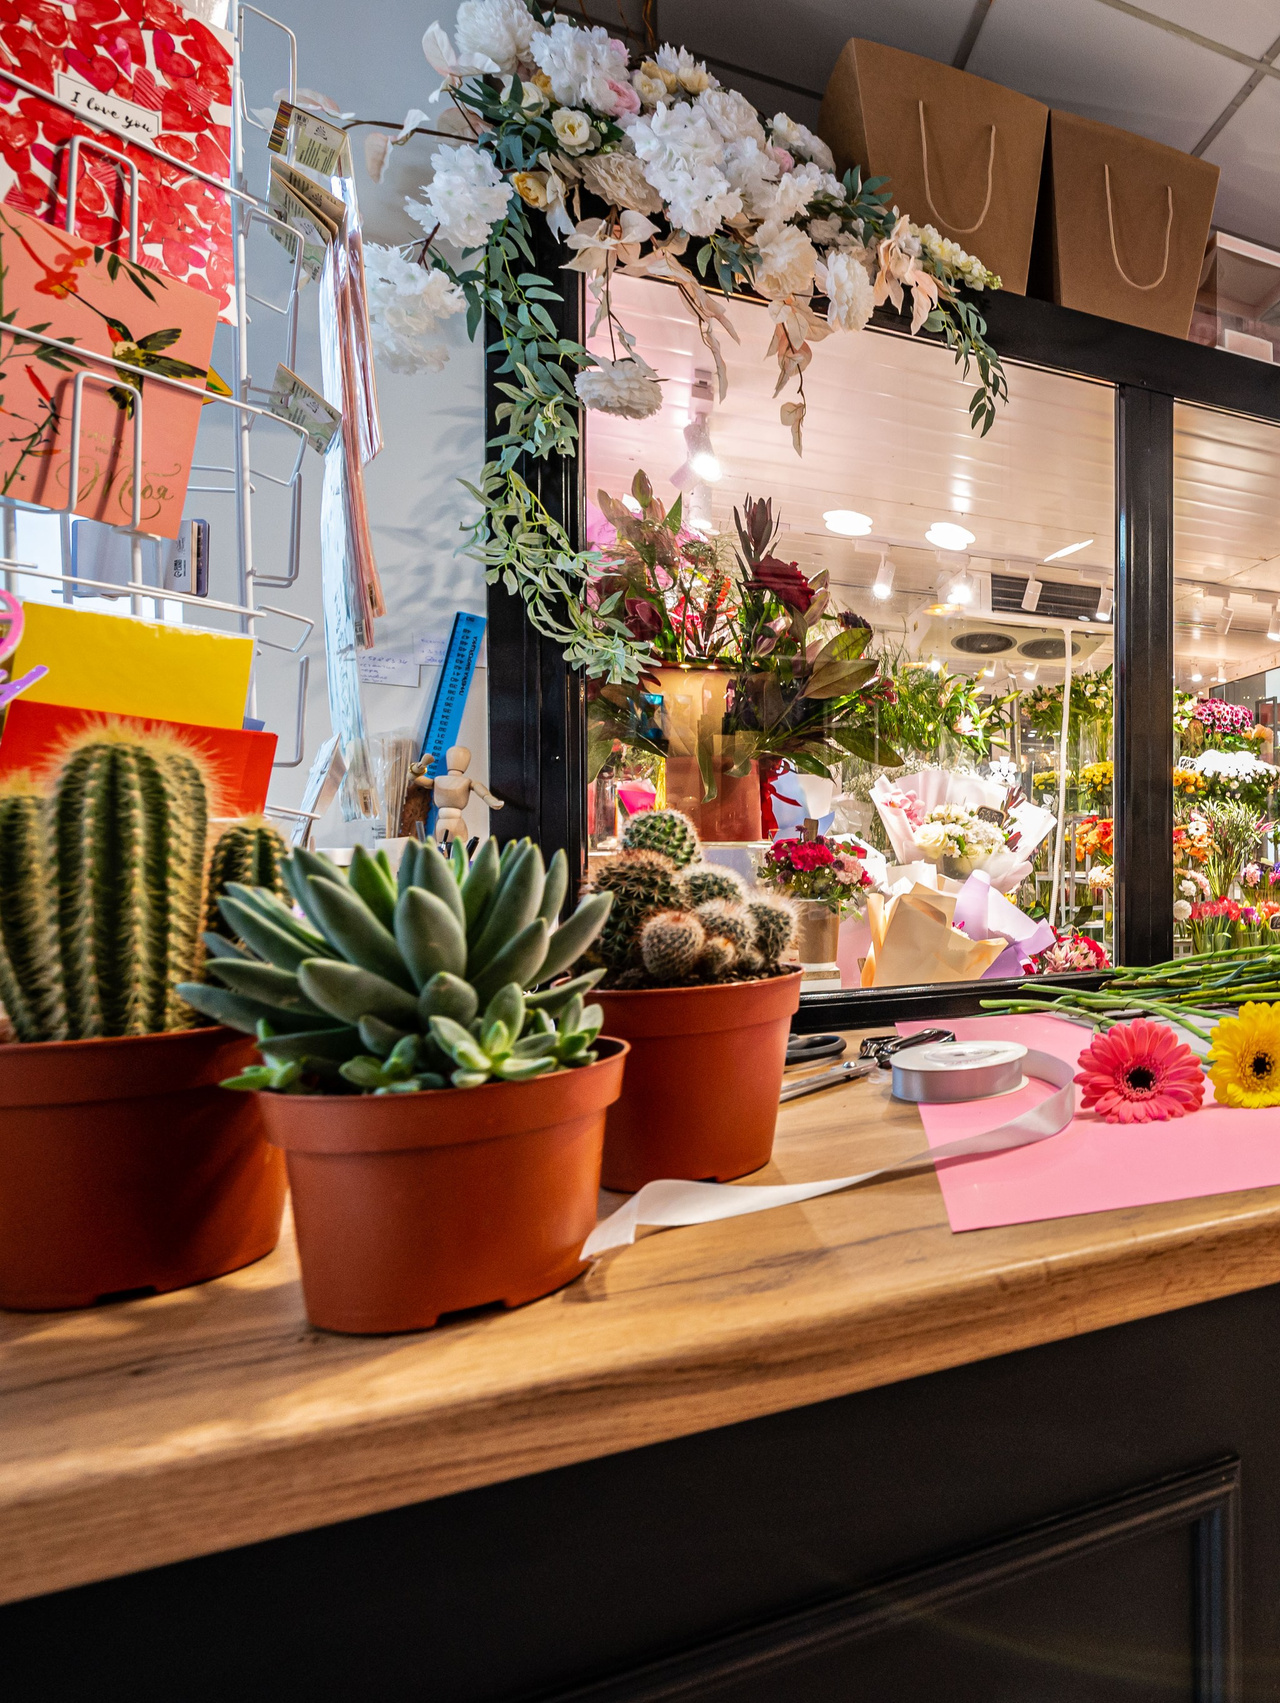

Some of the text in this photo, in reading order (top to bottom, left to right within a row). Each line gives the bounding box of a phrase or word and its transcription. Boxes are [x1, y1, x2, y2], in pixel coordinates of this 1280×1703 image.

[71, 91, 153, 133] I love you
